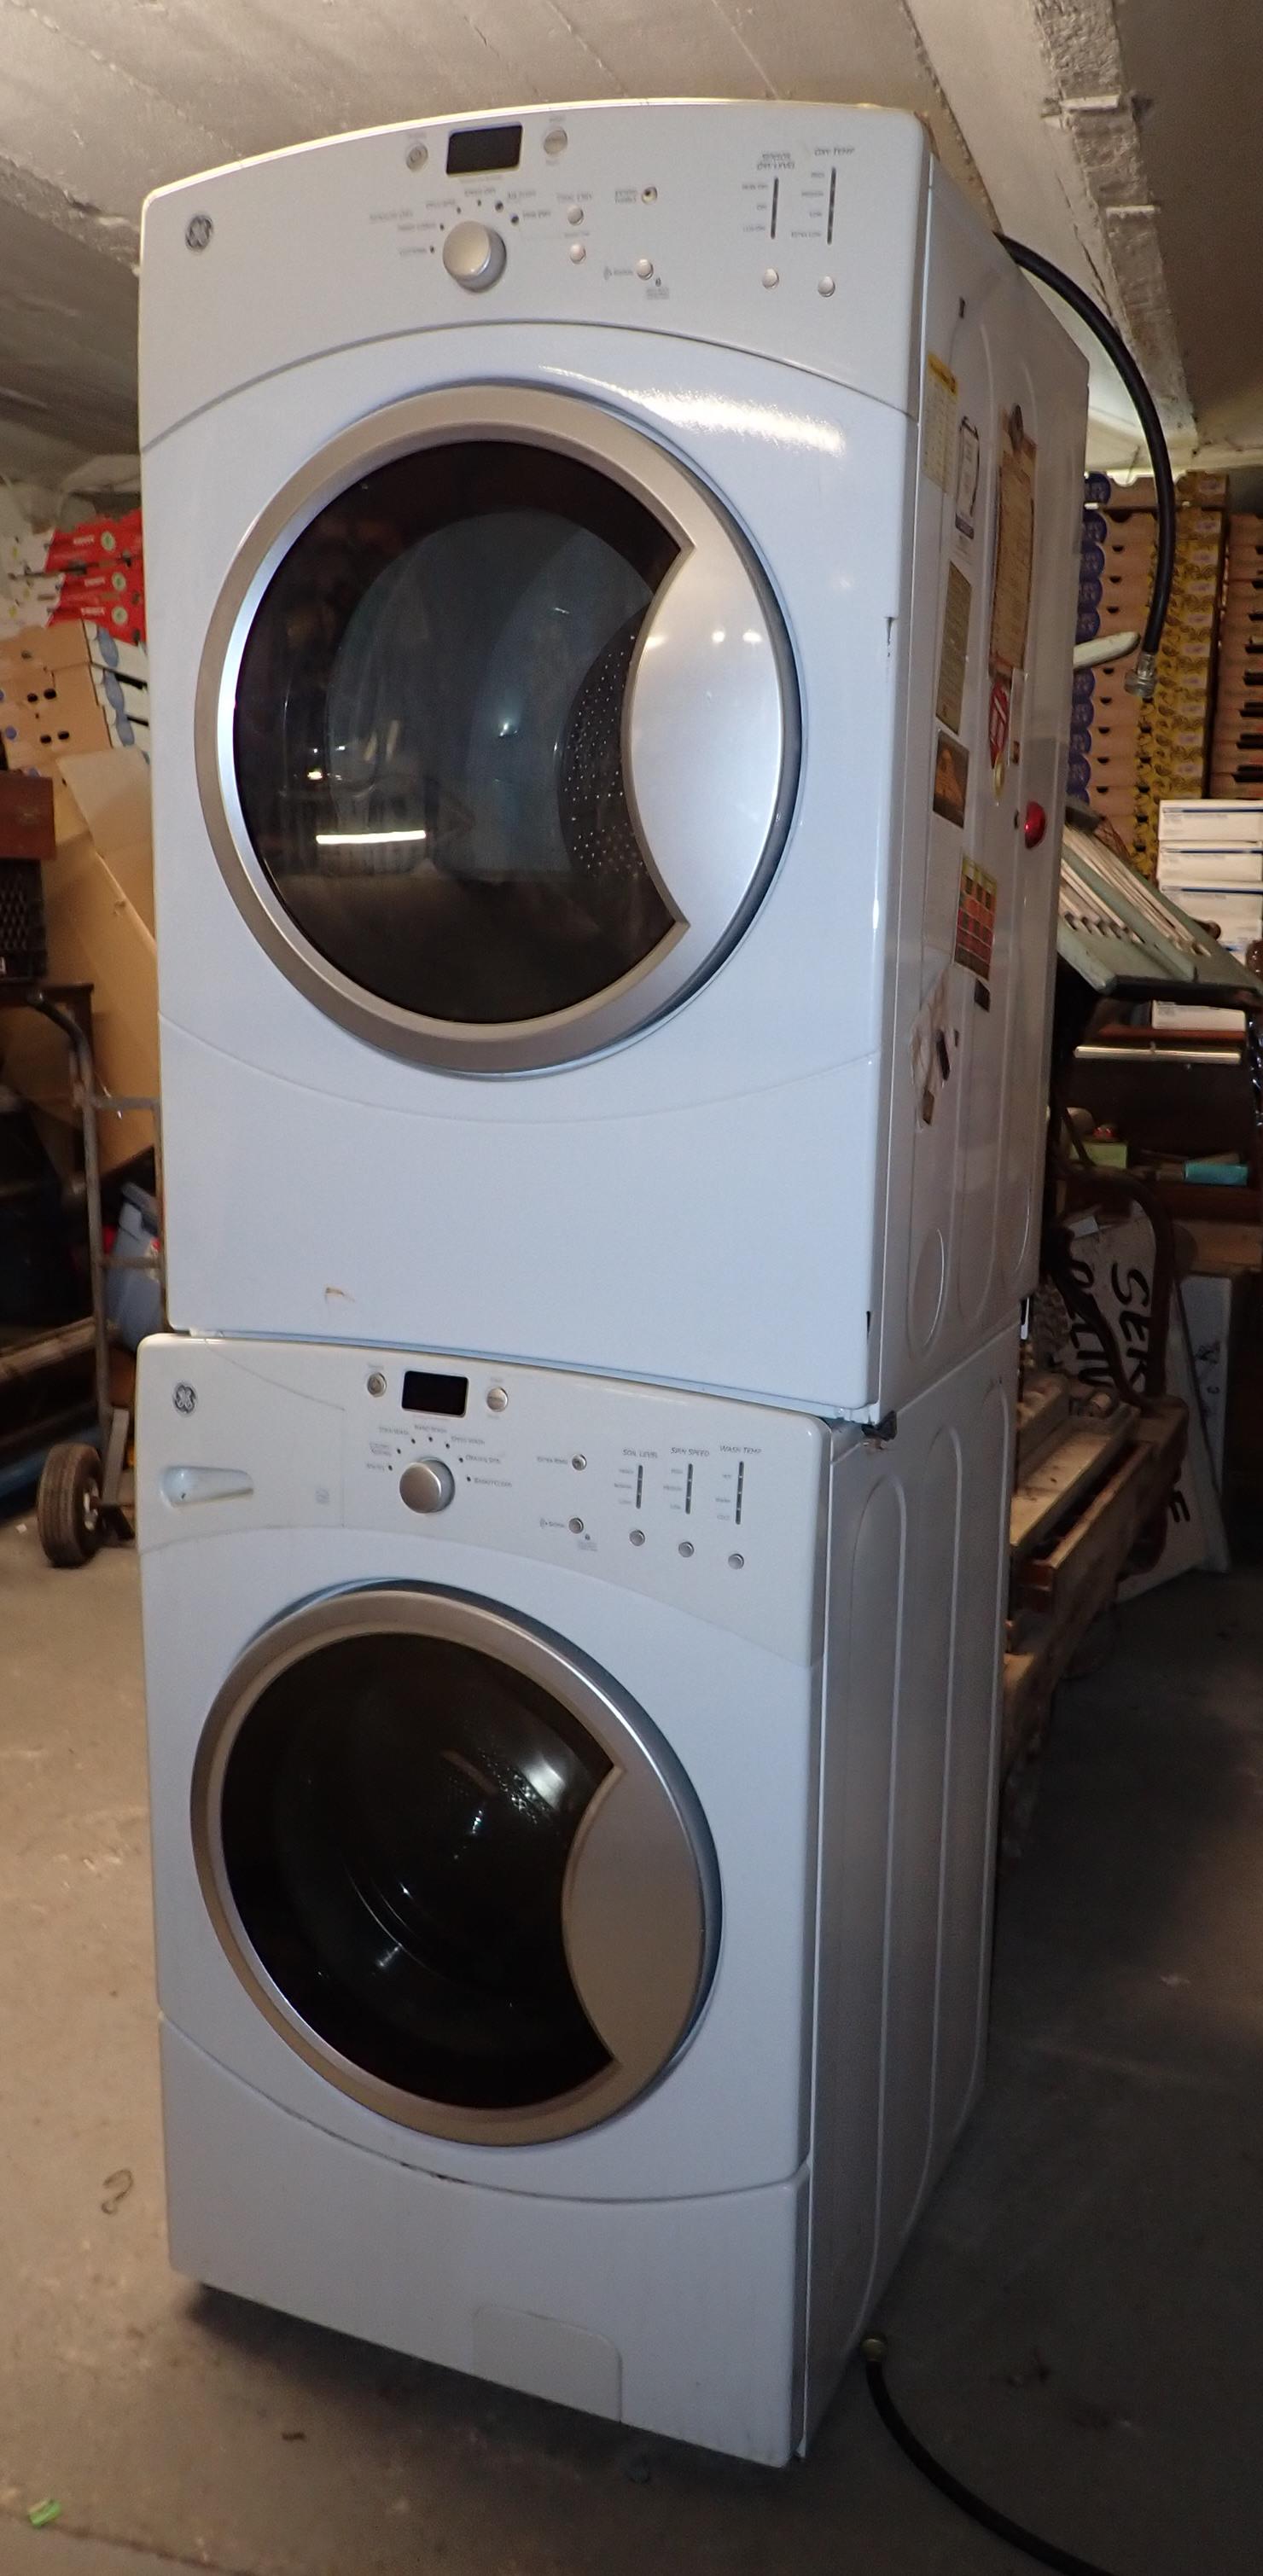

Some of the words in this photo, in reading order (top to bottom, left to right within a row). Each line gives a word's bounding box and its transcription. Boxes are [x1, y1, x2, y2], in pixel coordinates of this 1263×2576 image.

[689, 1448, 710, 1457] SPEED
[719, 1445, 741, 1454] WASH
[743, 1446, 762, 1455] TEMP
